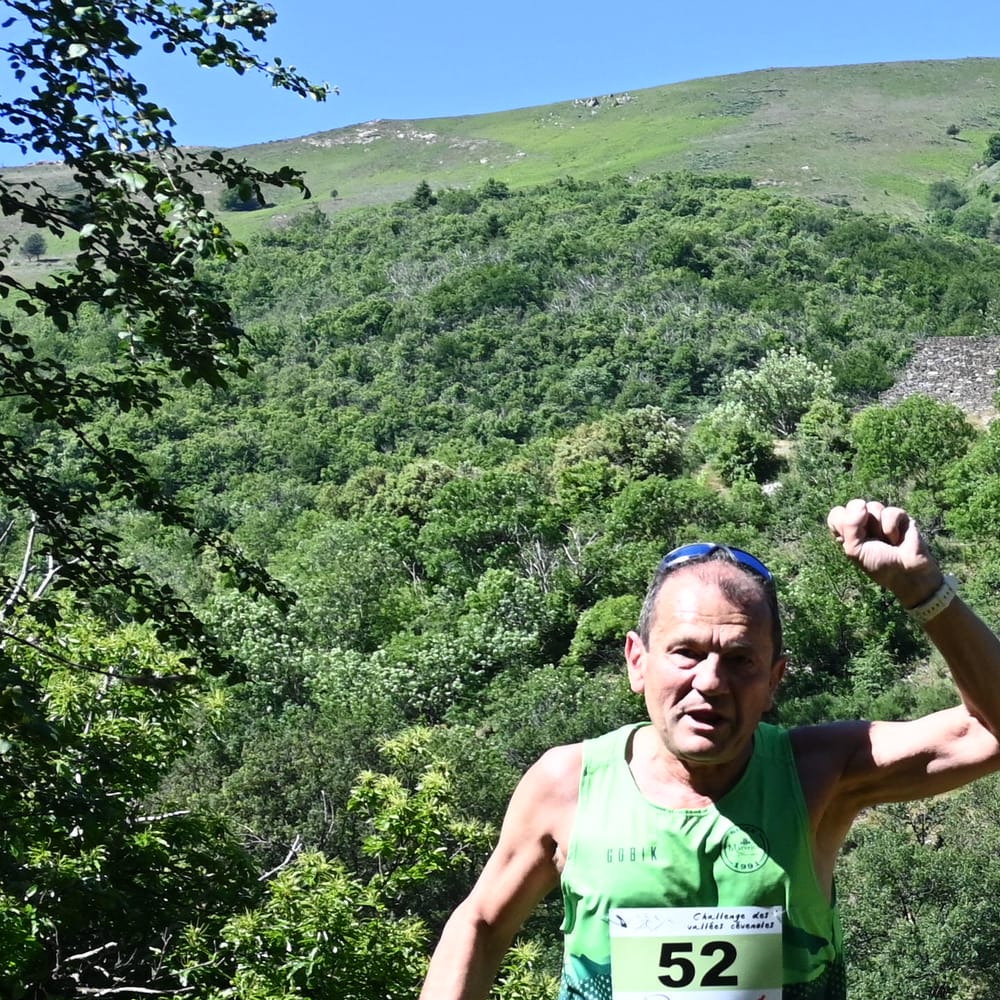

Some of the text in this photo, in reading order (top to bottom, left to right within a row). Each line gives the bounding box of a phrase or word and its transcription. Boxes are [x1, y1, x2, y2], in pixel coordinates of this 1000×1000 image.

[607, 846, 657, 863] GOBIK
[734, 860, 760, 870] 1991
[693, 911, 769, 923] Challenge des
[687, 920, 724, 930] vallées
[657, 940, 739, 989] 52
